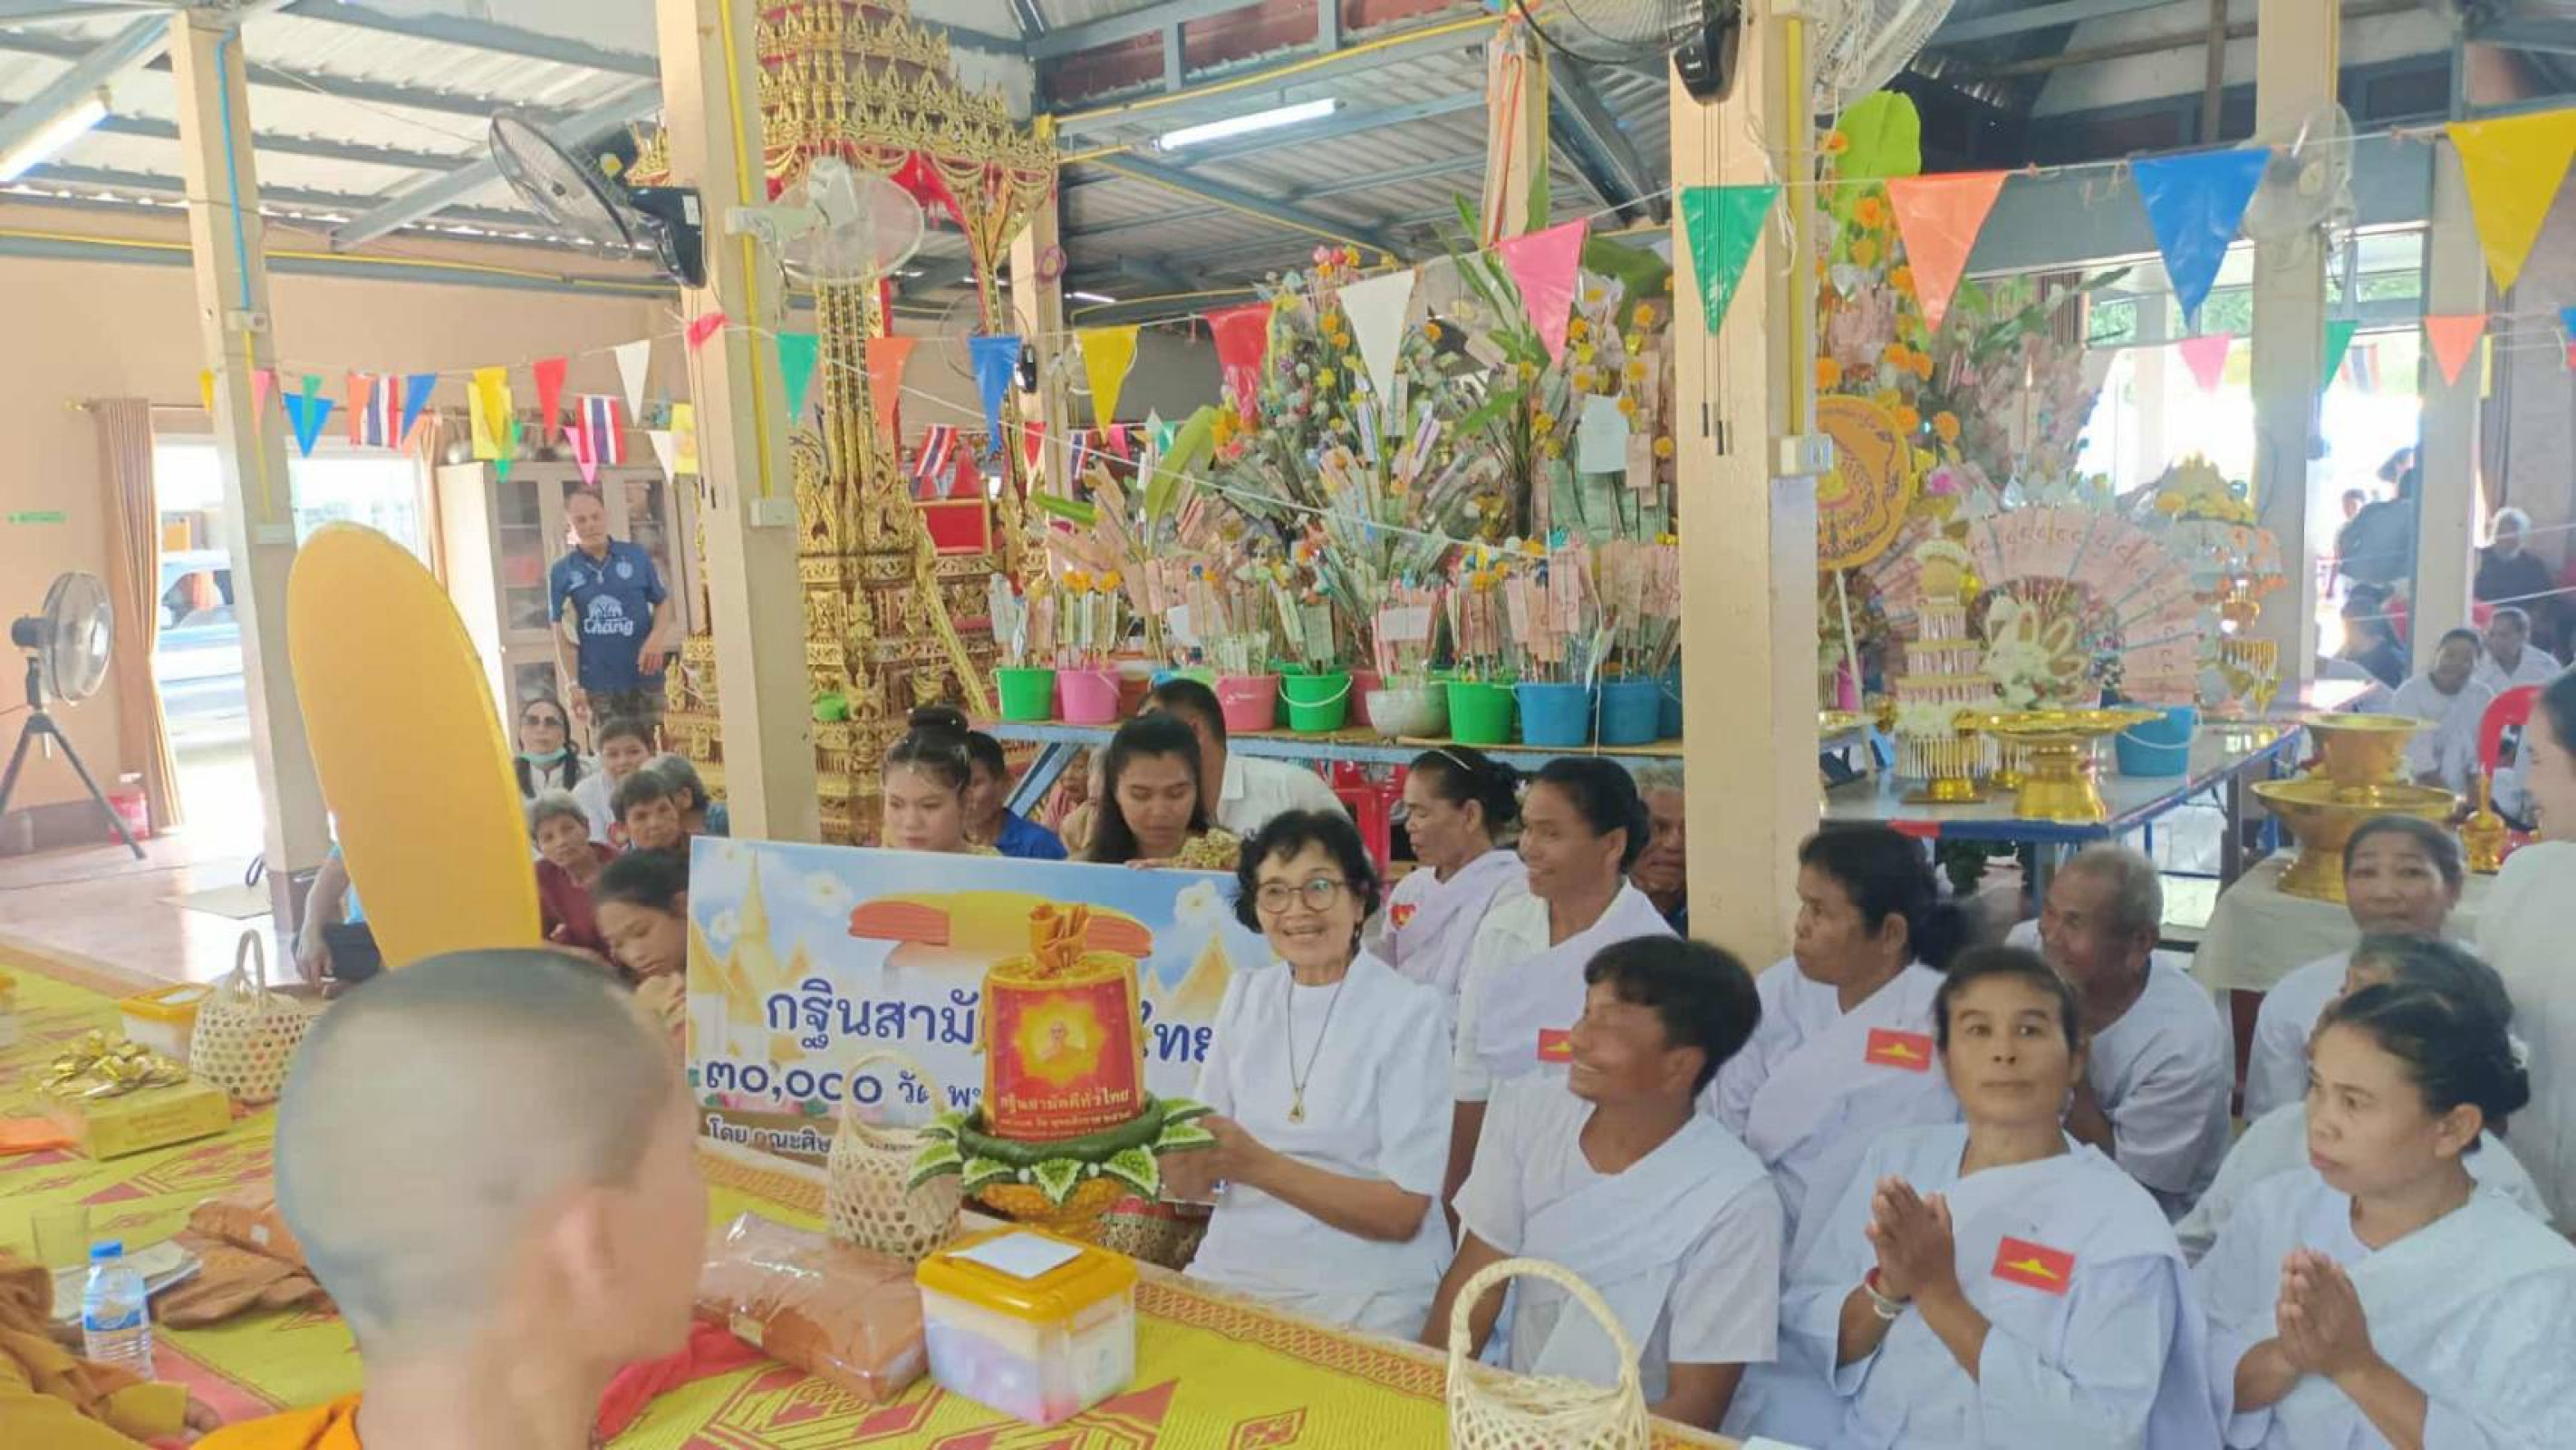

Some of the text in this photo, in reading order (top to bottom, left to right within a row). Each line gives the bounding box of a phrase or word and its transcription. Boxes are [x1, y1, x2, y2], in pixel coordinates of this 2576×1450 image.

[584, 617, 634, 636] Chang
[767, 978, 979, 1049] กฐินสามั
